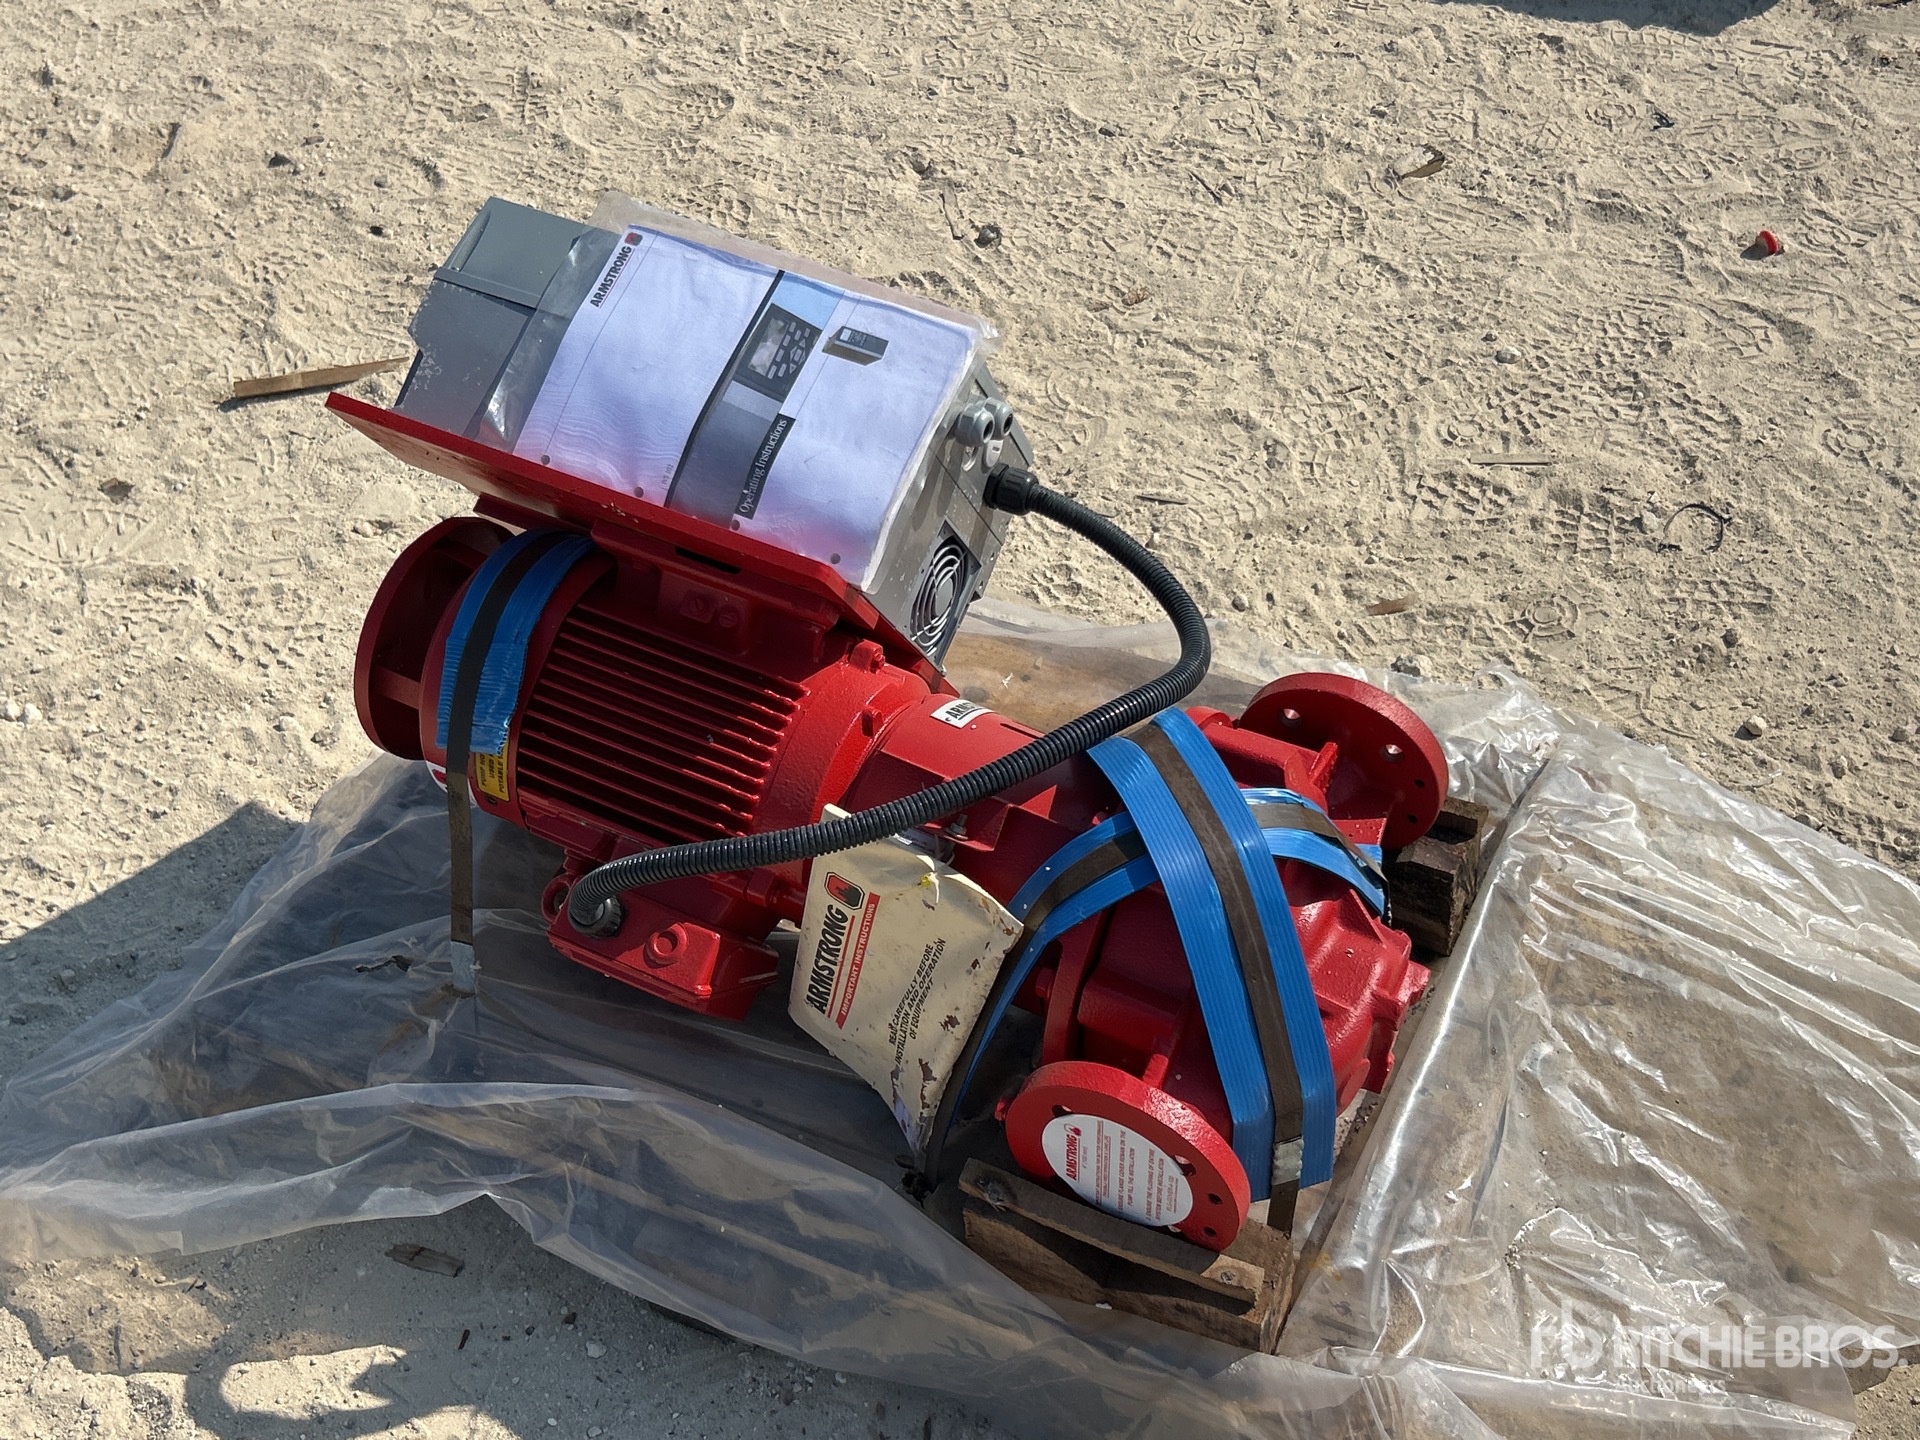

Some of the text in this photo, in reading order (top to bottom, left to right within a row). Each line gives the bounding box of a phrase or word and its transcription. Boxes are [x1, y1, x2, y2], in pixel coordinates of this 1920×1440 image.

[590, 246, 632, 308] ARMSTRONG
[739, 420, 788, 513] Operating Instructions
[807, 905, 848, 1014] ARMSTRONG
[841, 903, 875, 1015] IMPORTANT INSTRUCTIONS
[888, 943, 933, 1045] READ CAREFULLY BEFORE
[895, 937, 945, 1064] INSTALLATION AND OPERATION
[909, 977, 934, 1039] OF EQUIPMENT
[1066, 1134, 1077, 1181] ARMSTRONG
